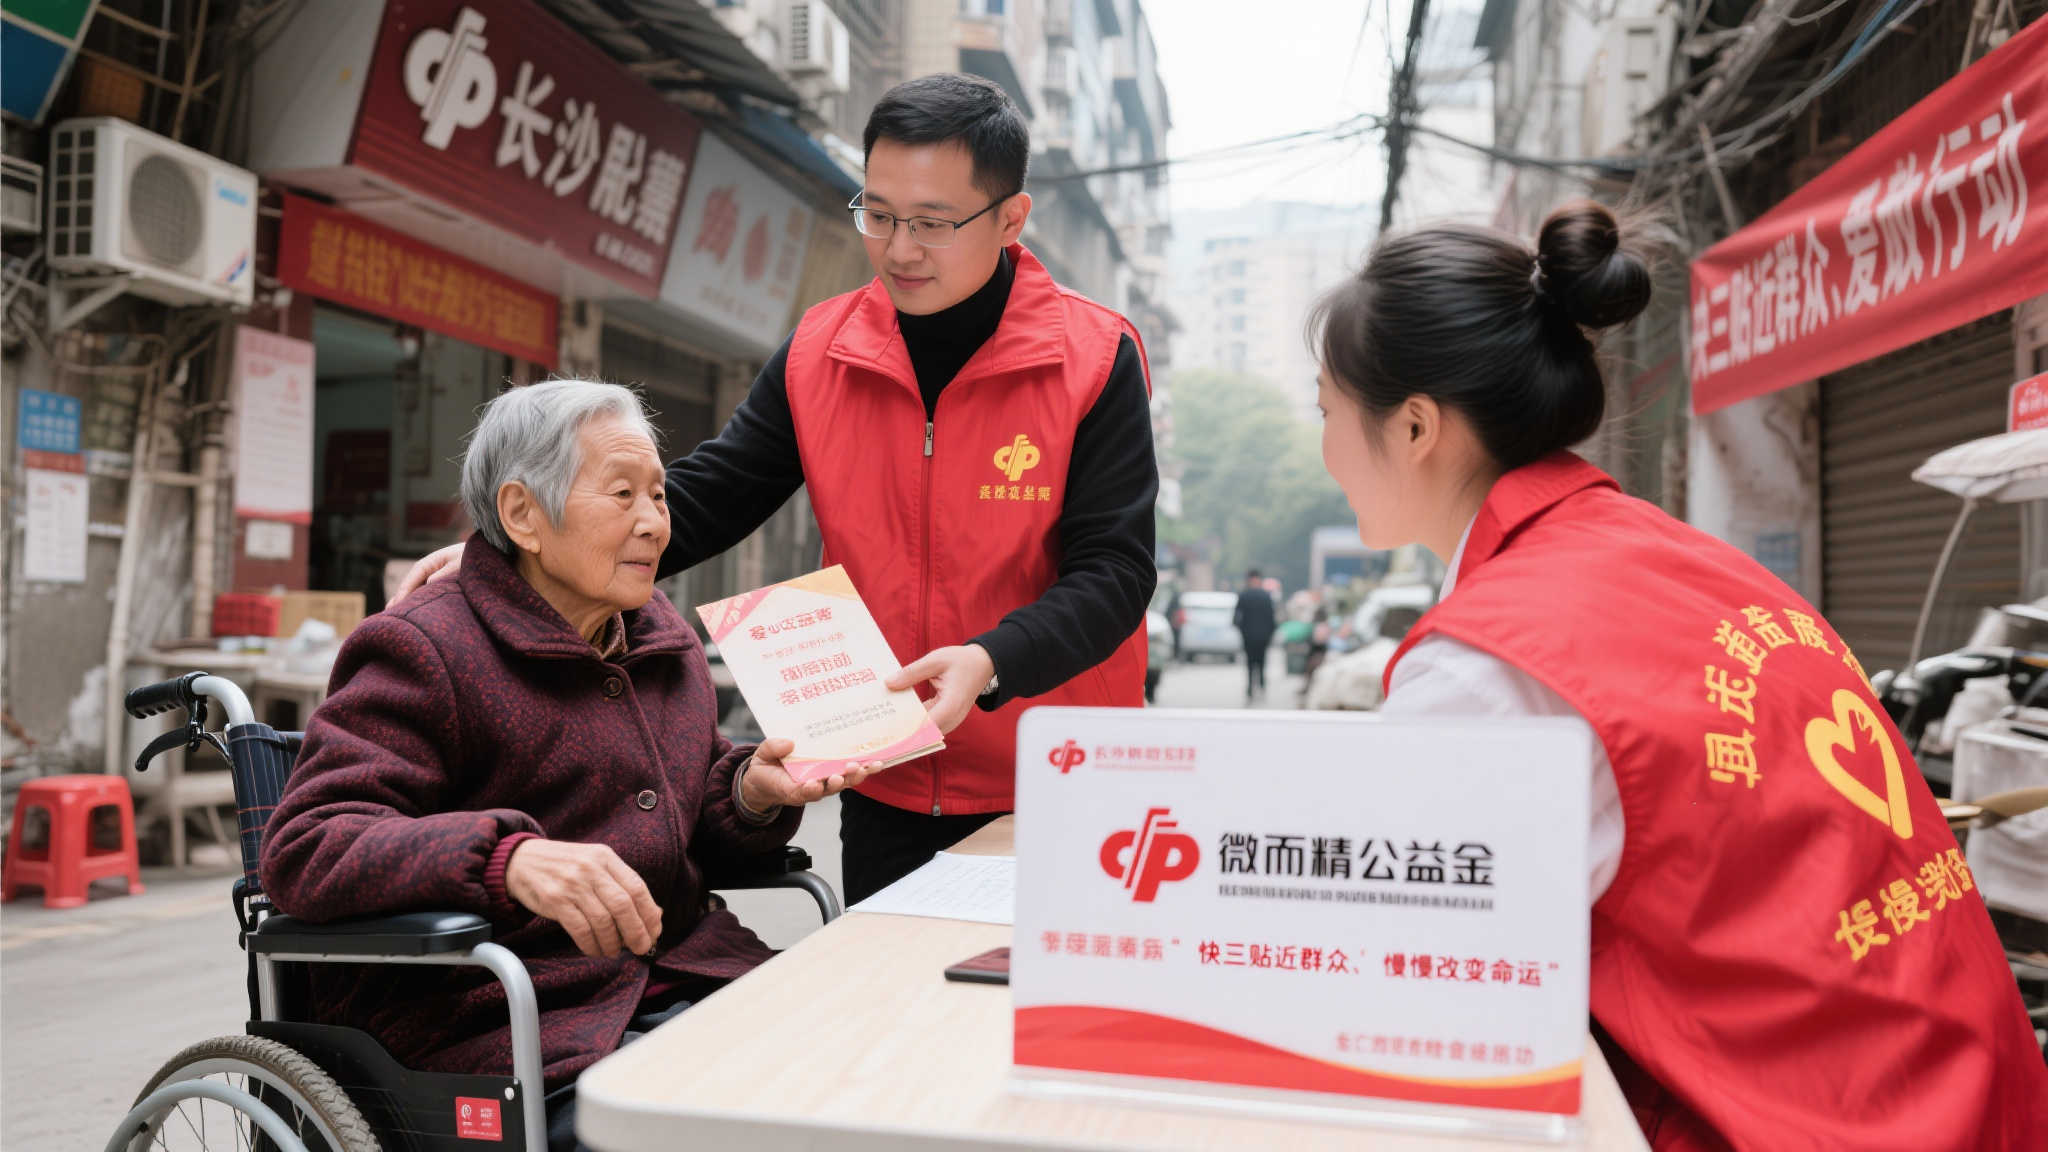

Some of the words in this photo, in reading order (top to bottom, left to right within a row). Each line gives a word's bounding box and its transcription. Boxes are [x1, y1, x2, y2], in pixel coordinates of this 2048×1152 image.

[1218, 831, 1494, 887] 微而精公益金
